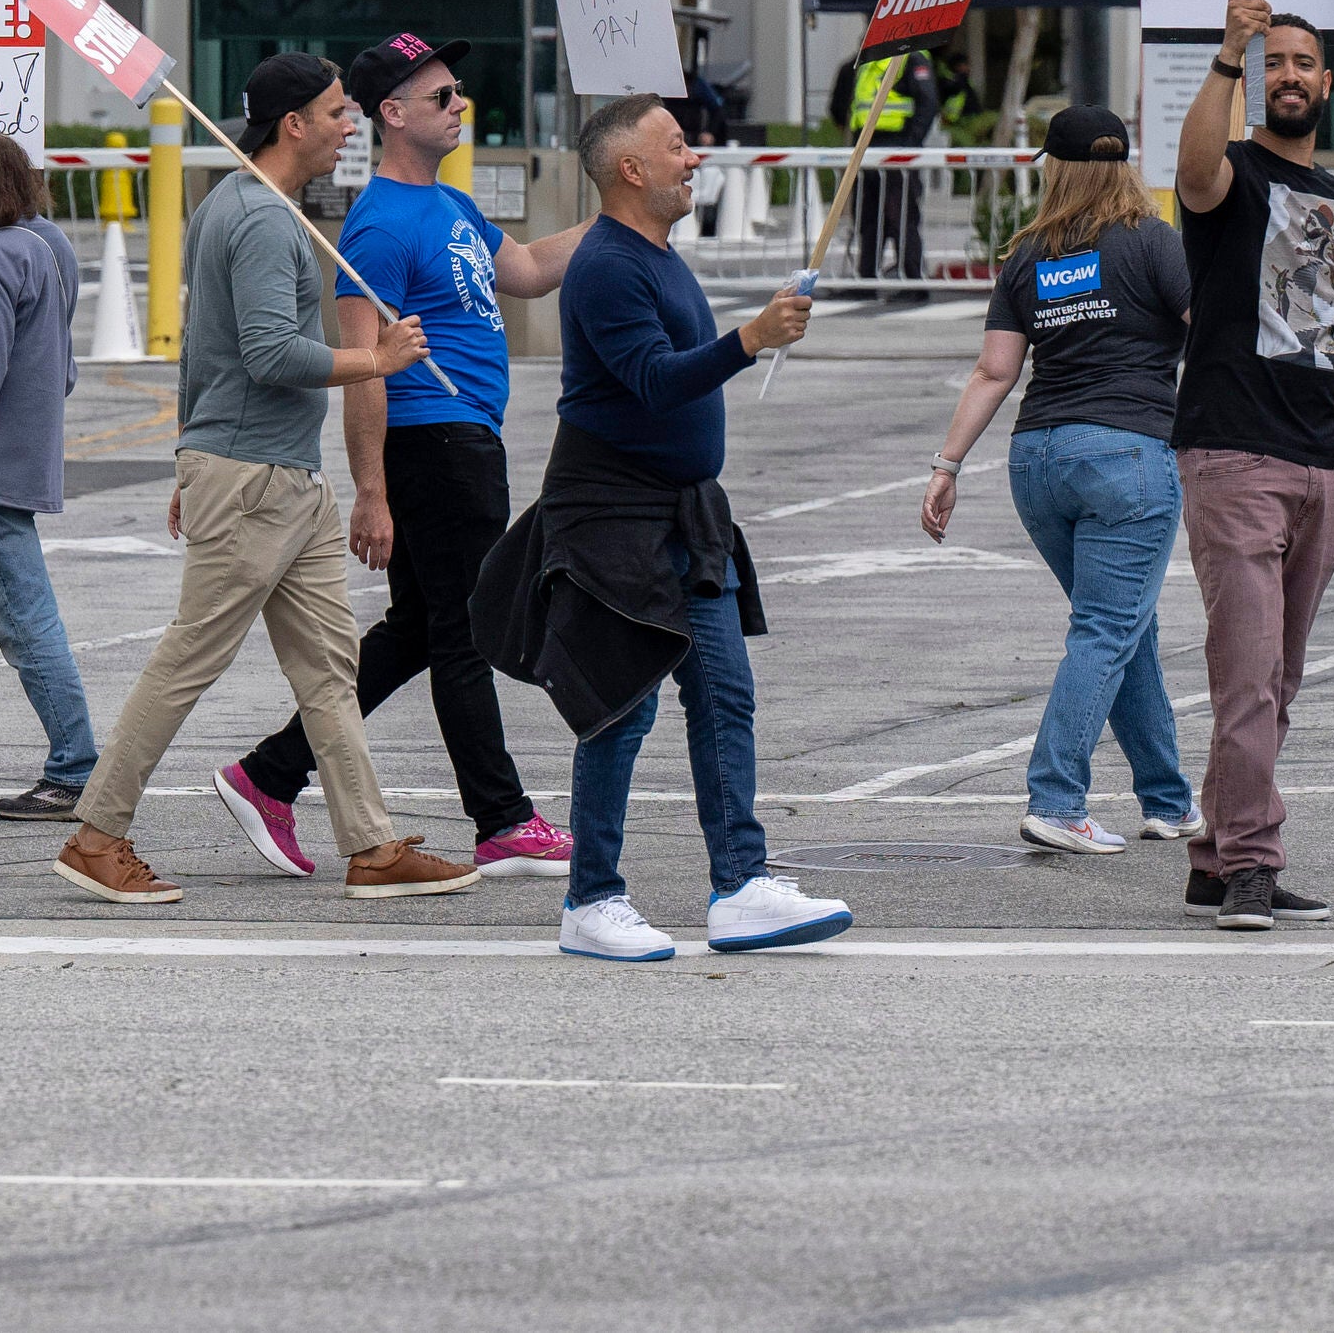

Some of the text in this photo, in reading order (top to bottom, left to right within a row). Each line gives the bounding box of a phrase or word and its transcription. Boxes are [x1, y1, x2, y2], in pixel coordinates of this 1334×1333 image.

[593, 9, 638, 58] PAY
[401, 38, 433, 61] BIT
[451, 257, 473, 313] WRITERS
[1039, 263, 1097, 287] WGAW
[1033, 321, 1043, 329] OF
[1086, 308, 1118, 320] WEST
[1035, 299, 1110, 320] WRITERS GUILD
